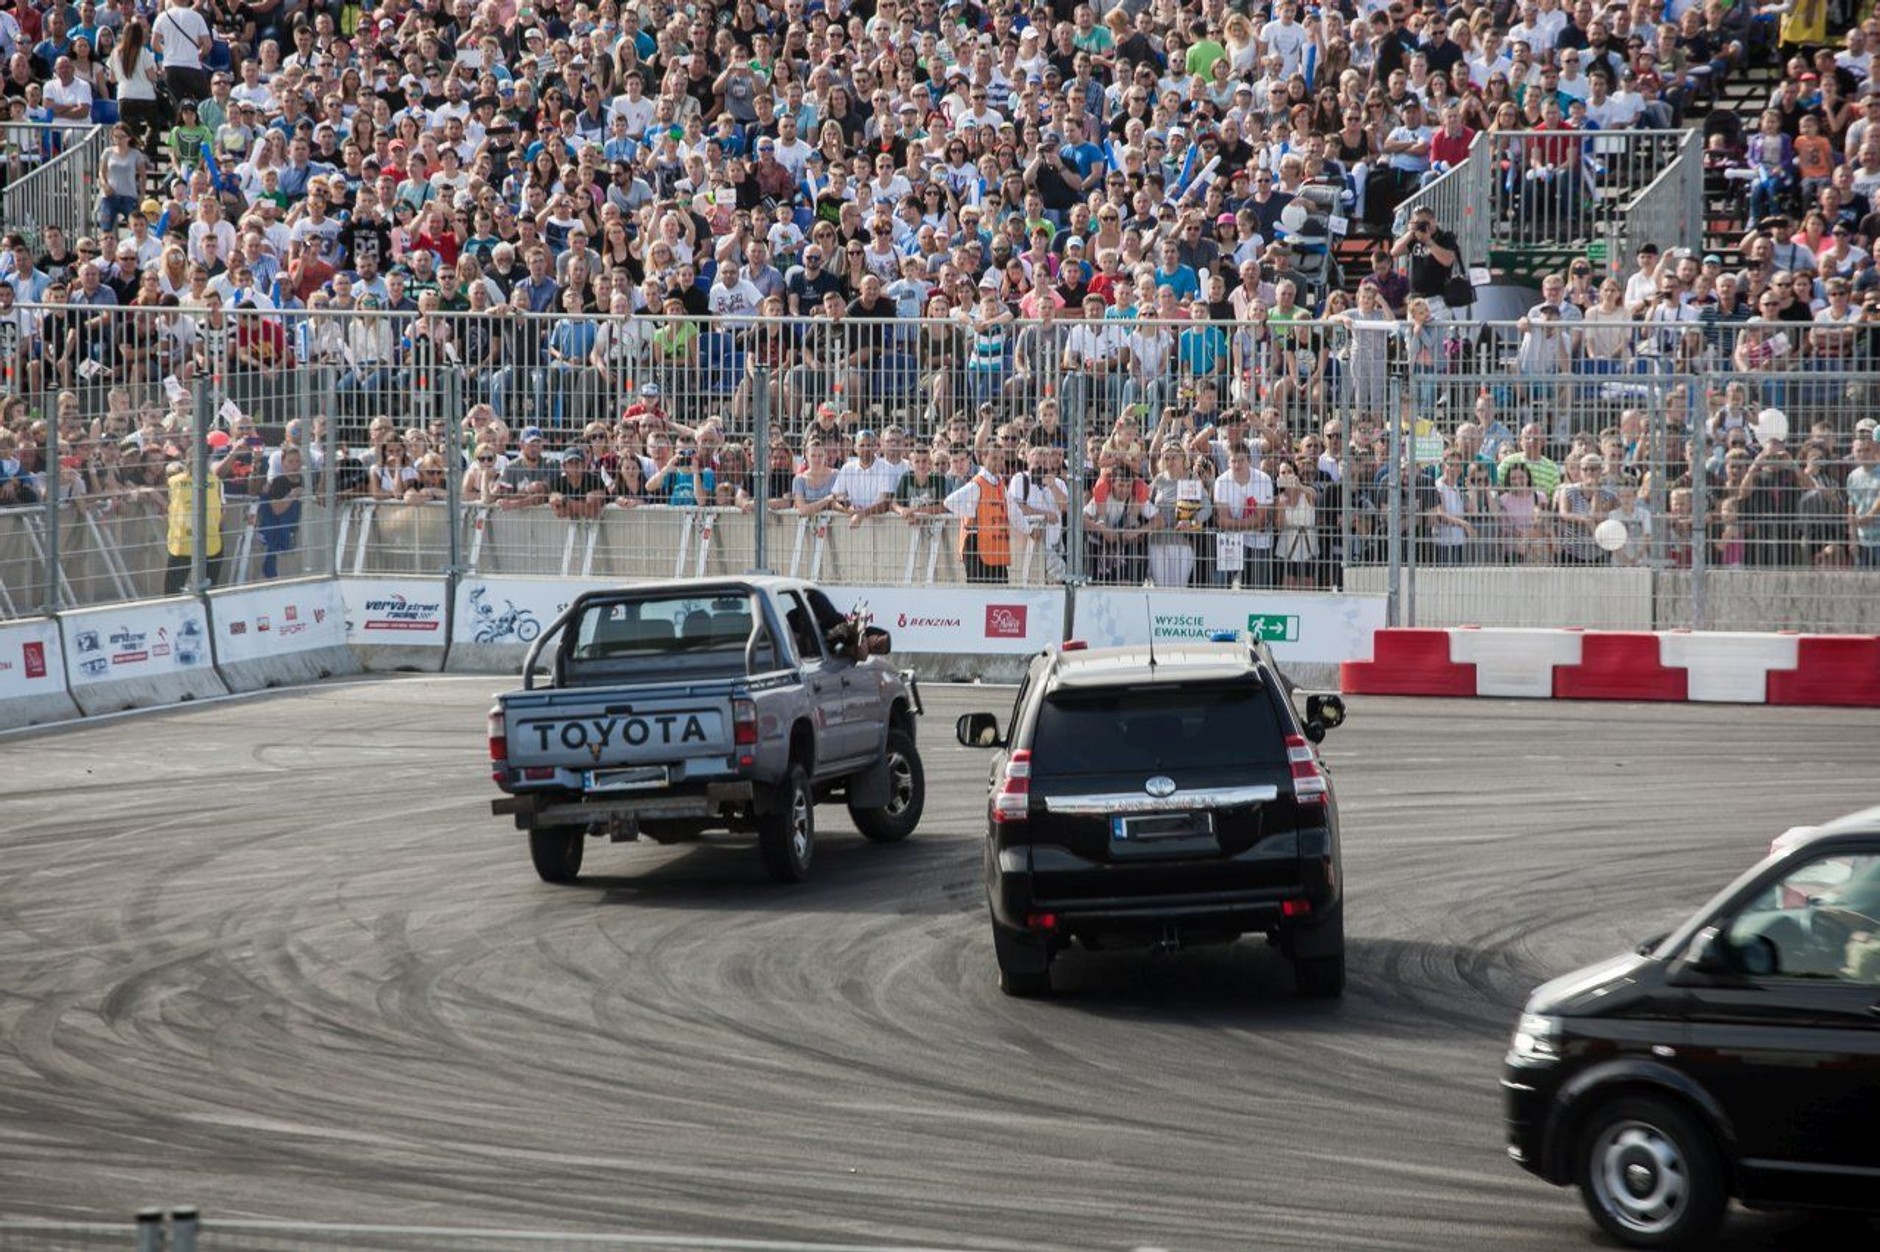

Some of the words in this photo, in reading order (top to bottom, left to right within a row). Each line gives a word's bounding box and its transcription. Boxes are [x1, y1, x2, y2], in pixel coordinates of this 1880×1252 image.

[365, 600, 406, 610] verva
[407, 602, 439, 611] street
[910, 617, 961, 627] BENZINA
[1155, 614, 1204, 626] WYJŚCIE
[279, 622, 306, 635] SPORT
[533, 715, 707, 751] TOYOTA
